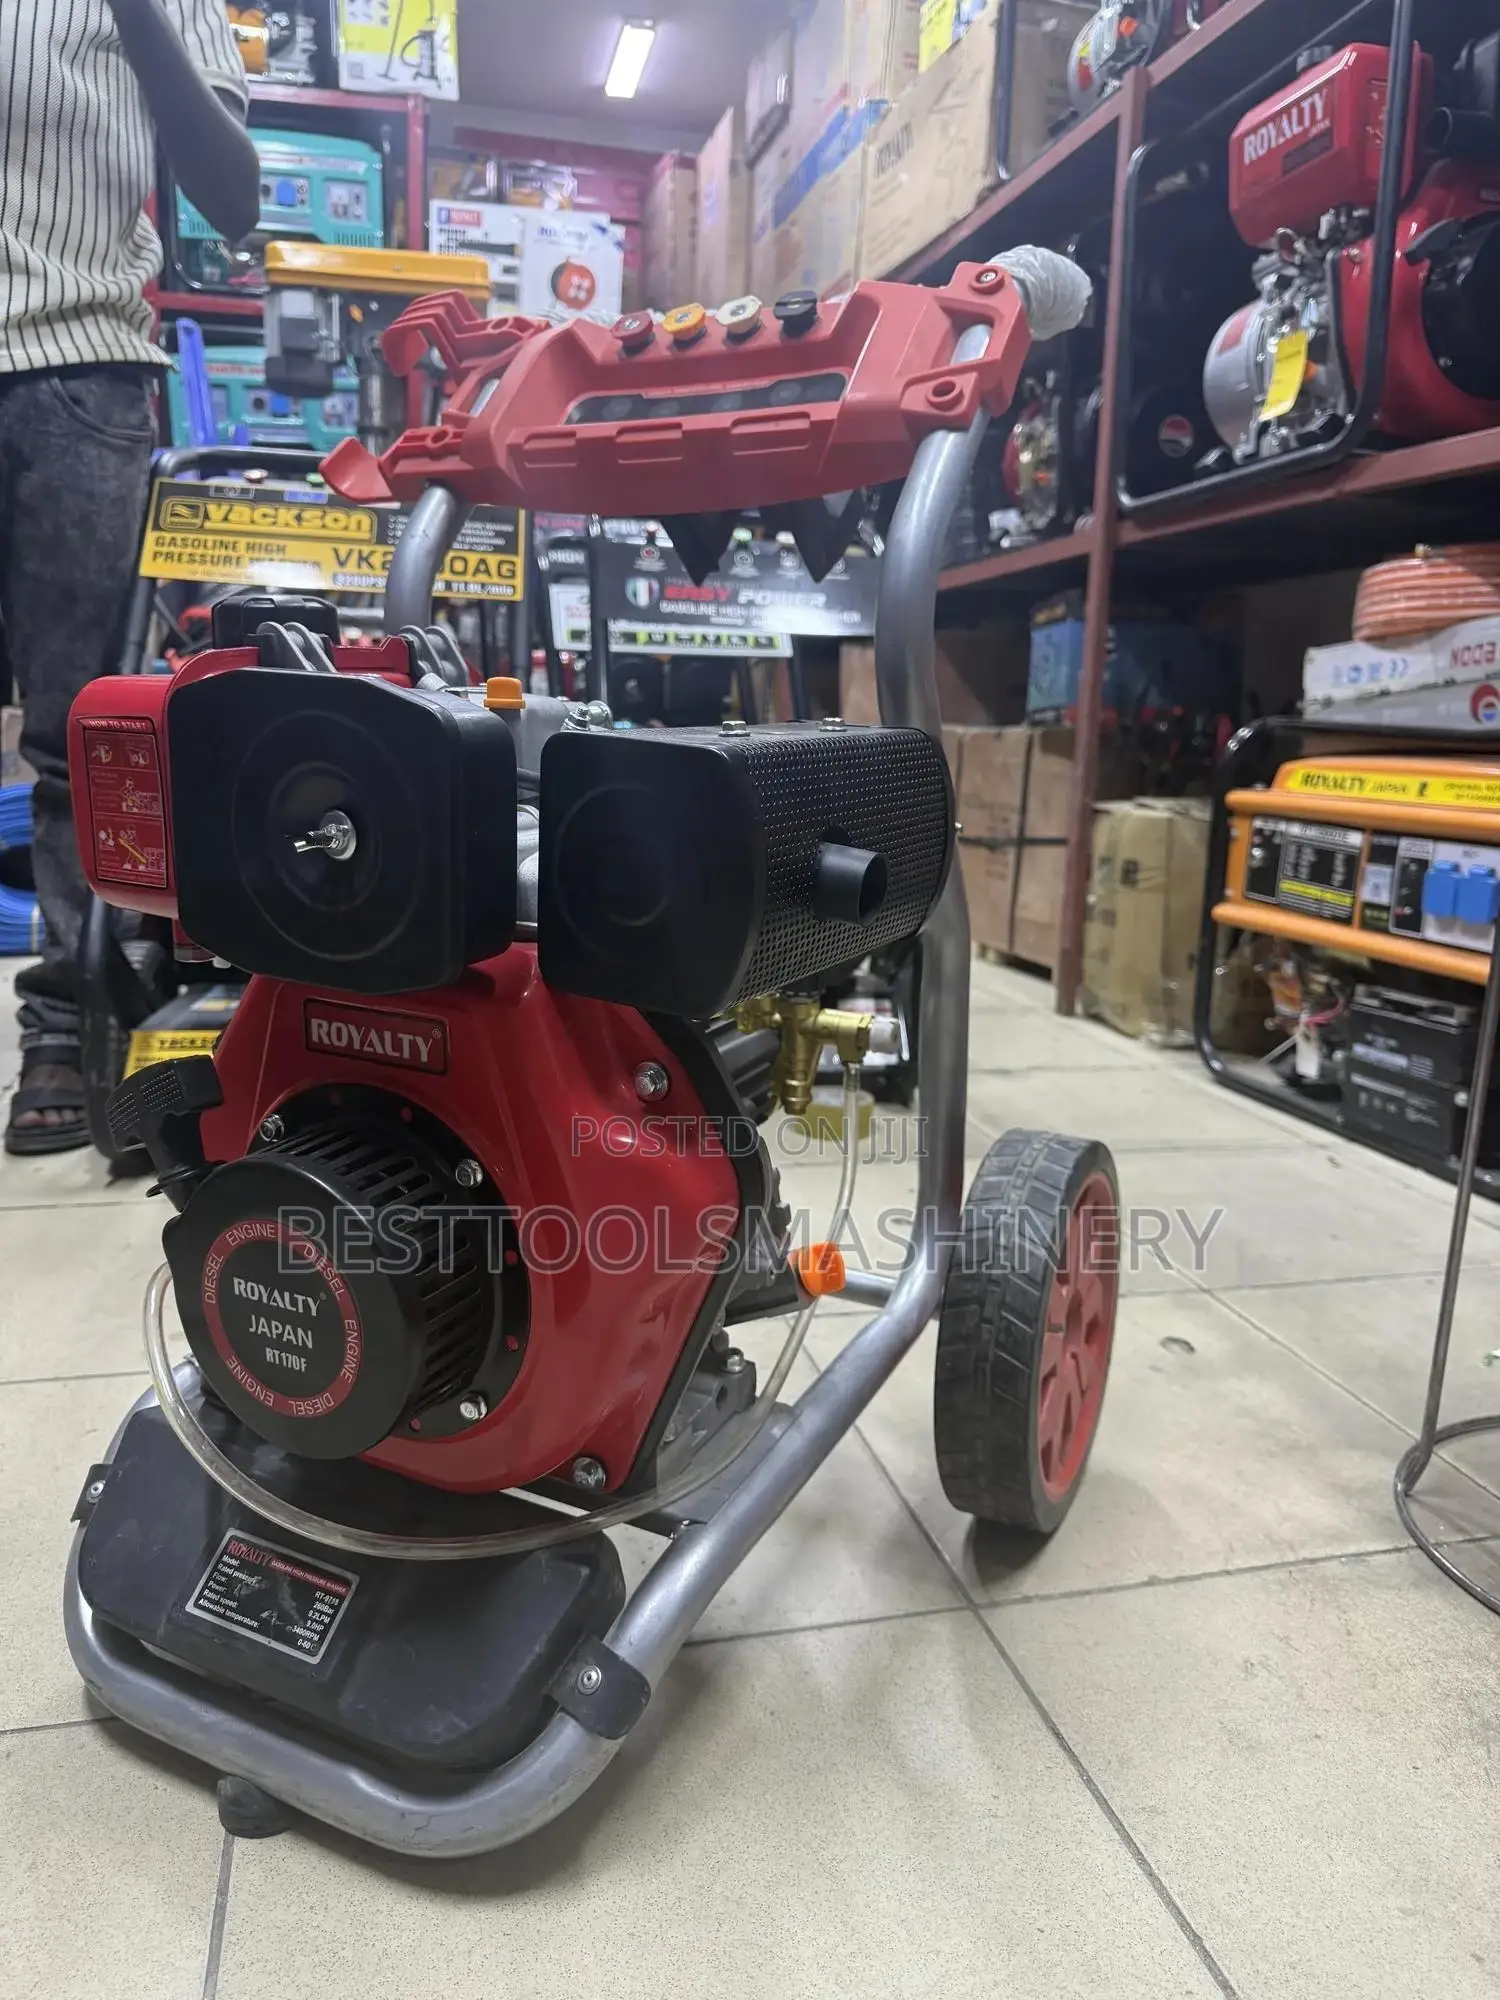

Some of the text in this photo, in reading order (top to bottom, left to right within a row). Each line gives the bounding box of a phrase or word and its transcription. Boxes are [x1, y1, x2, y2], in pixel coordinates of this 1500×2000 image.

[1243, 87, 1328, 166] ROYALTY
[154, 536, 287, 555] GASOLINE HIGH
[152, 552, 243, 566] PRESSURE
[110, 720, 120, 728] TO
[121, 721, 147, 731] START
[310, 1017, 433, 1063] ROYALTY
[232, 1276, 321, 1317] ROYALTY
[204, 1222, 362, 1416] ENGINE DIESEL ENGINE DIESEL ENGINE DIESEL
[248, 1314, 314, 1349] JAPAN
[265, 1347, 308, 1373] RT170F
[221, 1554, 240, 1567] Model:
[227, 1540, 273, 1566] ROYALTY
[217, 1563, 234, 1575] Rated
[203, 1588, 220, 1601] Rated
[219, 1596, 239, 1609] speed:
[198, 1598, 226, 1615] Allowable
[225, 1608, 260, 1629] temperature:
